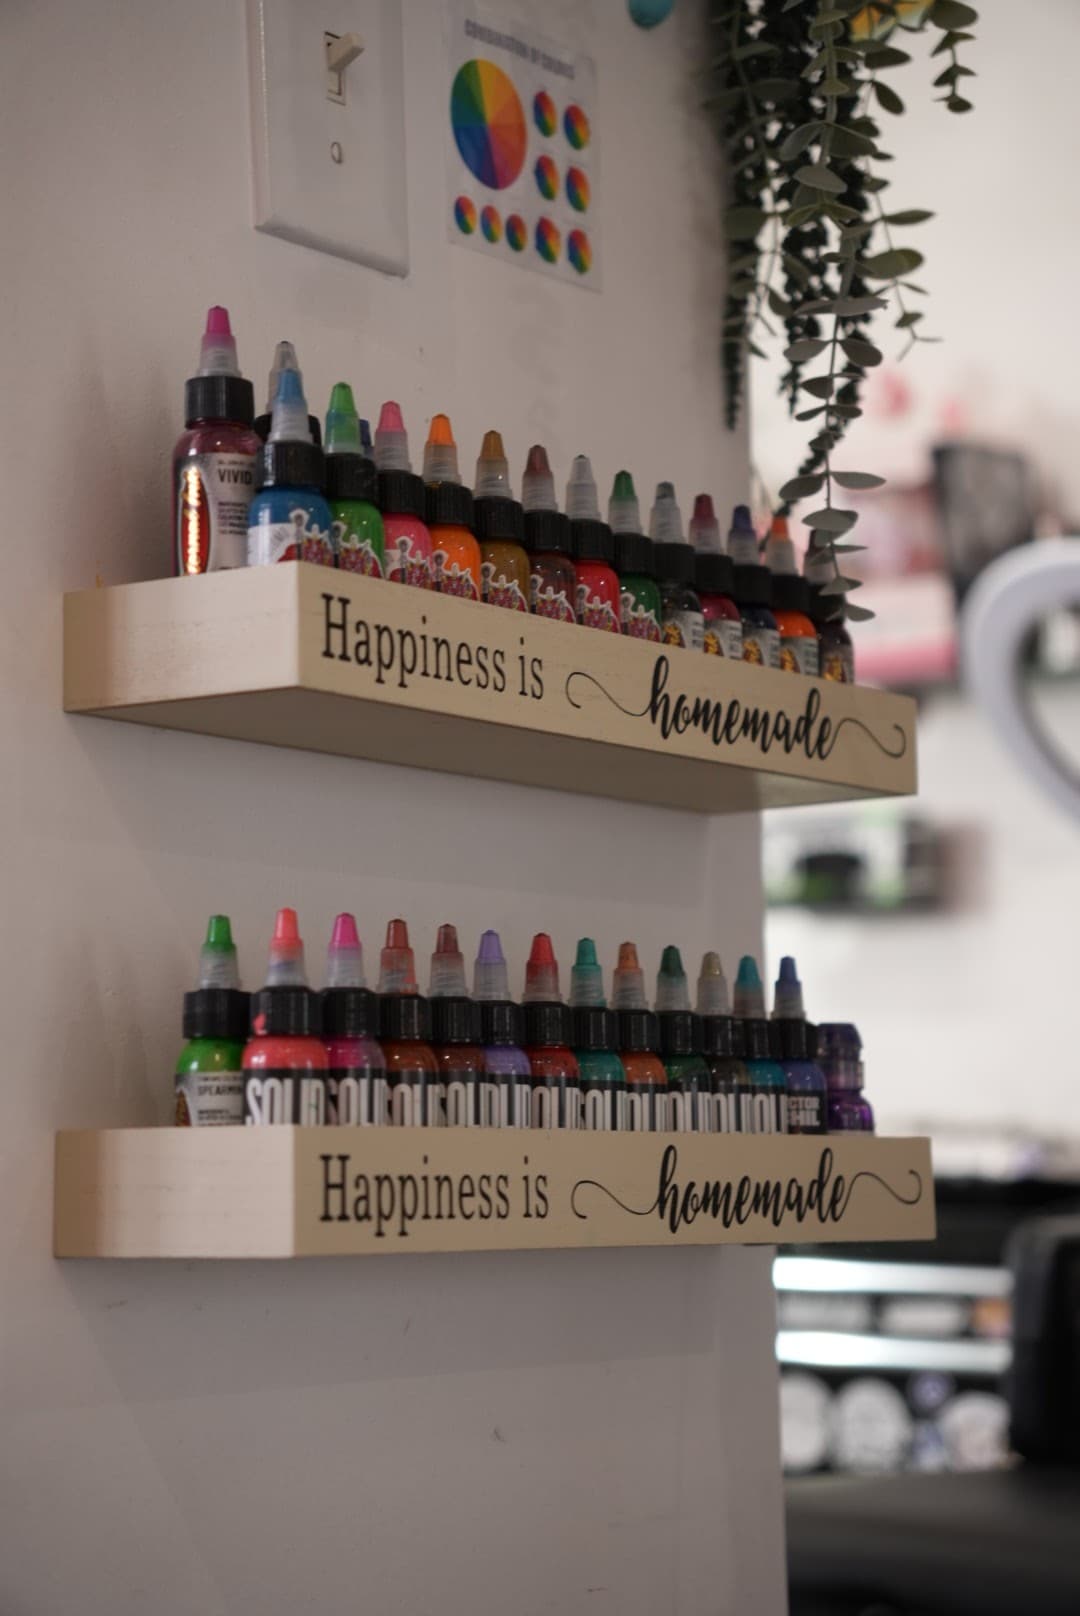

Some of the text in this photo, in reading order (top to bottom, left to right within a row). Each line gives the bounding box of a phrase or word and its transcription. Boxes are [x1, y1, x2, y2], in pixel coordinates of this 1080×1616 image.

[218, 468, 252, 485] VIVID
[321, 592, 833, 760] Happiness is homemade
[197, 1085, 242, 1097] SPEARM
[246, 1077, 325, 1126] SOLID
[320, 1144, 849, 1237] Happiness is homemade
